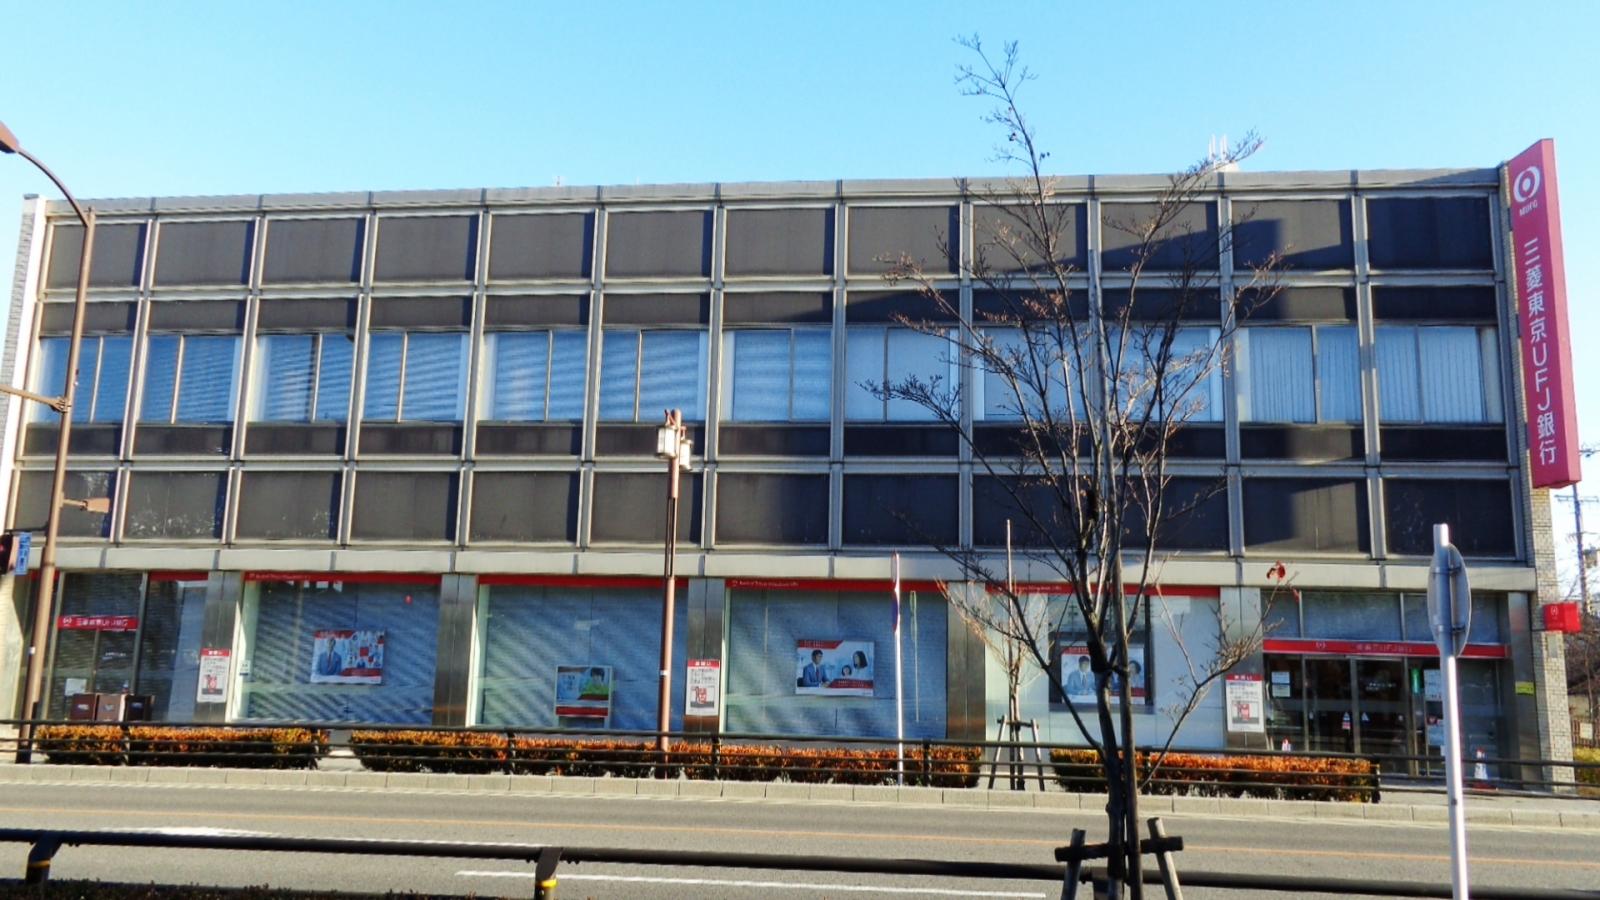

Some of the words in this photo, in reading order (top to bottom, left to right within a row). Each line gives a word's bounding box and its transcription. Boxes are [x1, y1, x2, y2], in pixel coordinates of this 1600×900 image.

[1524, 237, 1557, 466] 三菱東京UFJ銀行
